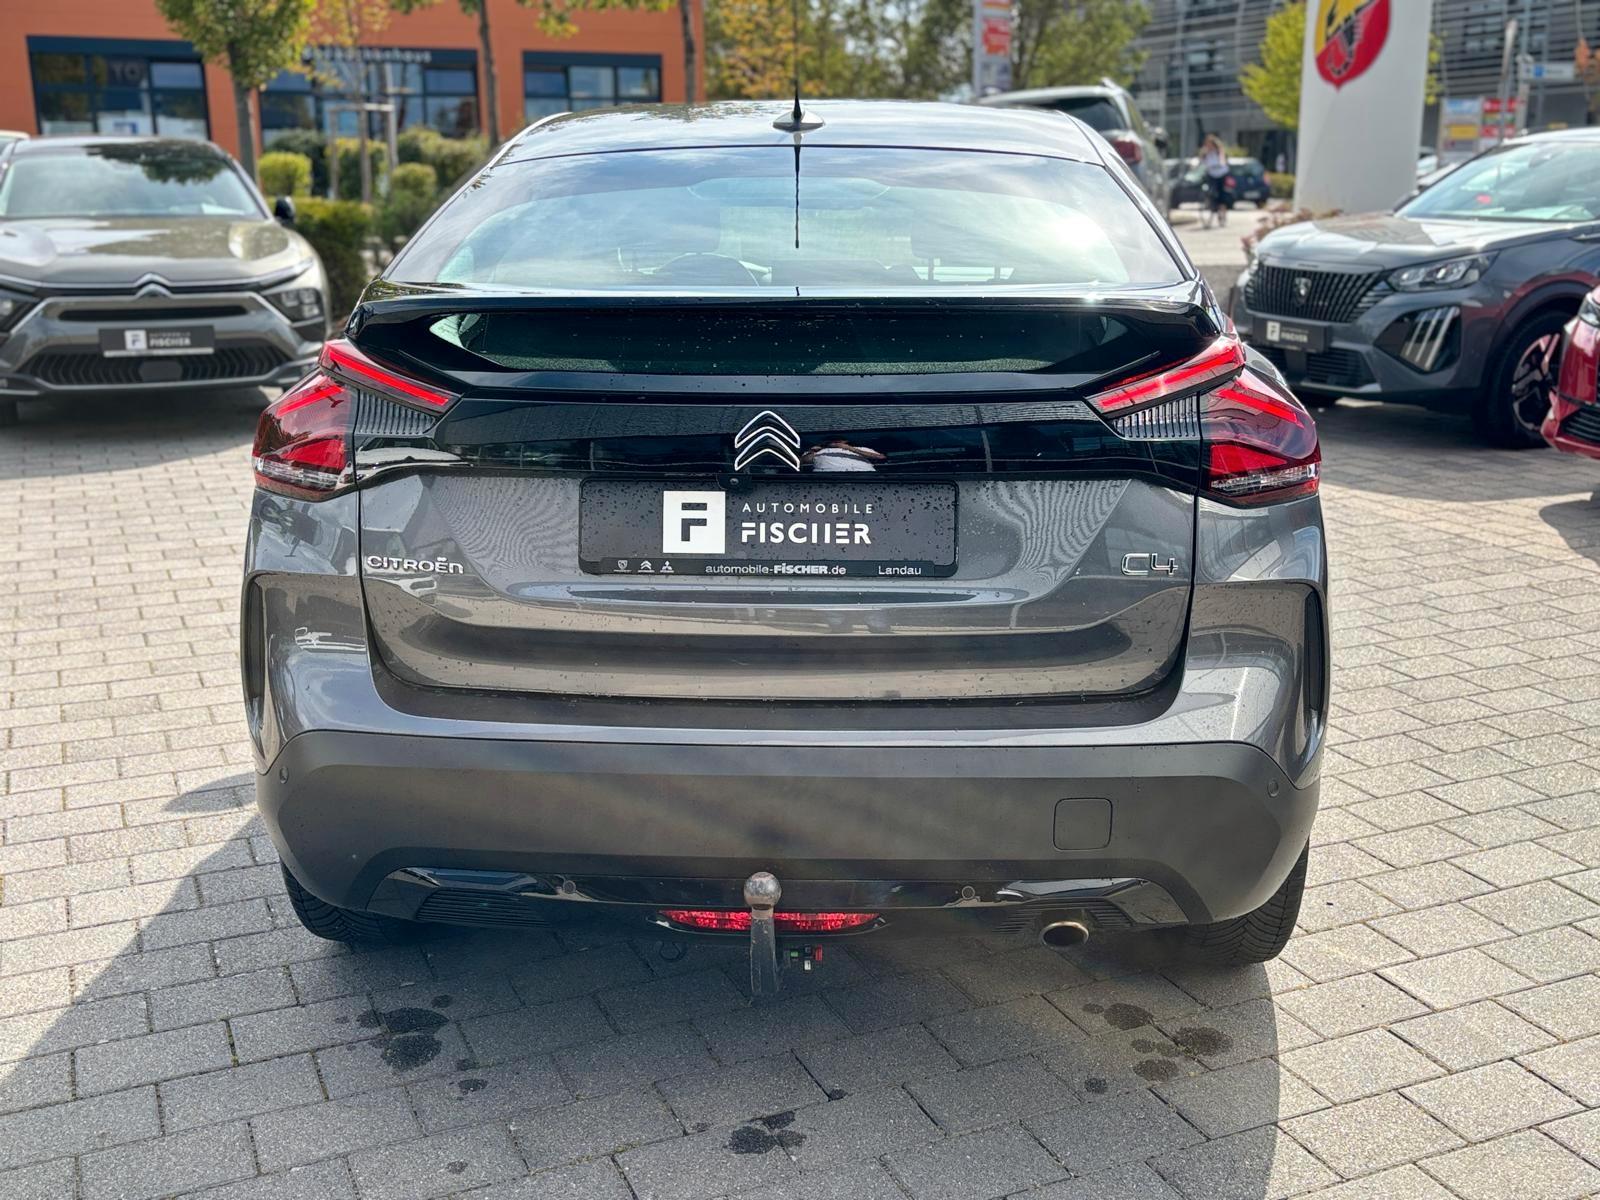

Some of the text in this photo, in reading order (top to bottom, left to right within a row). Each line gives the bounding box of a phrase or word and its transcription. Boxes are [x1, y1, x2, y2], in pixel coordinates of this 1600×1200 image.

[742, 503, 873, 514] AUTOMOBILE
[878, 565, 922, 575] Landau
[1121, 553, 1179, 576] C4
